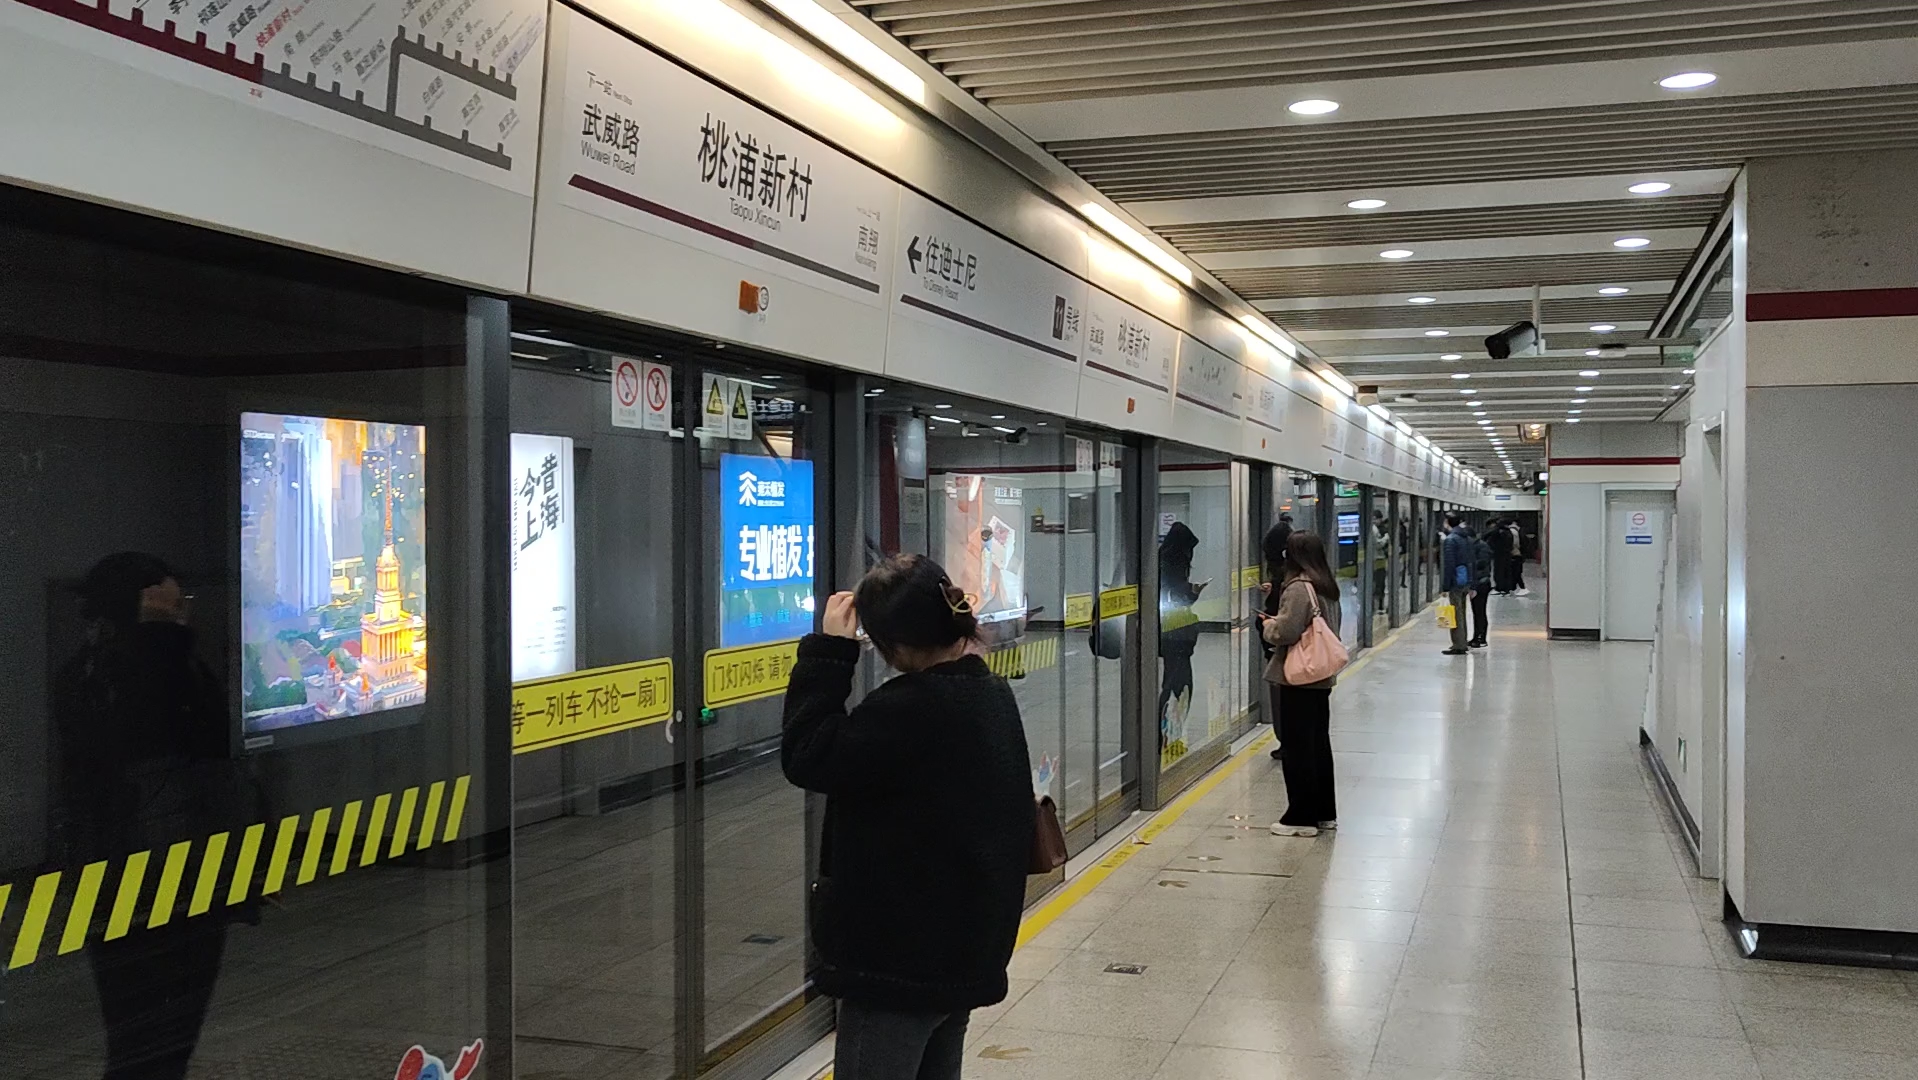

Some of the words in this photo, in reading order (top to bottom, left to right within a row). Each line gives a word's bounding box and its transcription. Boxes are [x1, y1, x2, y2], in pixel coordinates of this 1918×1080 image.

[581, 139, 611, 166] Wuwei
[612, 152, 636, 175] Road
[582, 103, 640, 158] 武威路
[697, 112, 813, 223] 桃浦新村
[729, 196, 754, 222] Taopu
[926, 234, 977, 291] 往迪士尼
[520, 493, 560, 552] 上海
[739, 524, 803, 581] 专业植发
[712, 657, 765, 693] 门灯闪烁
